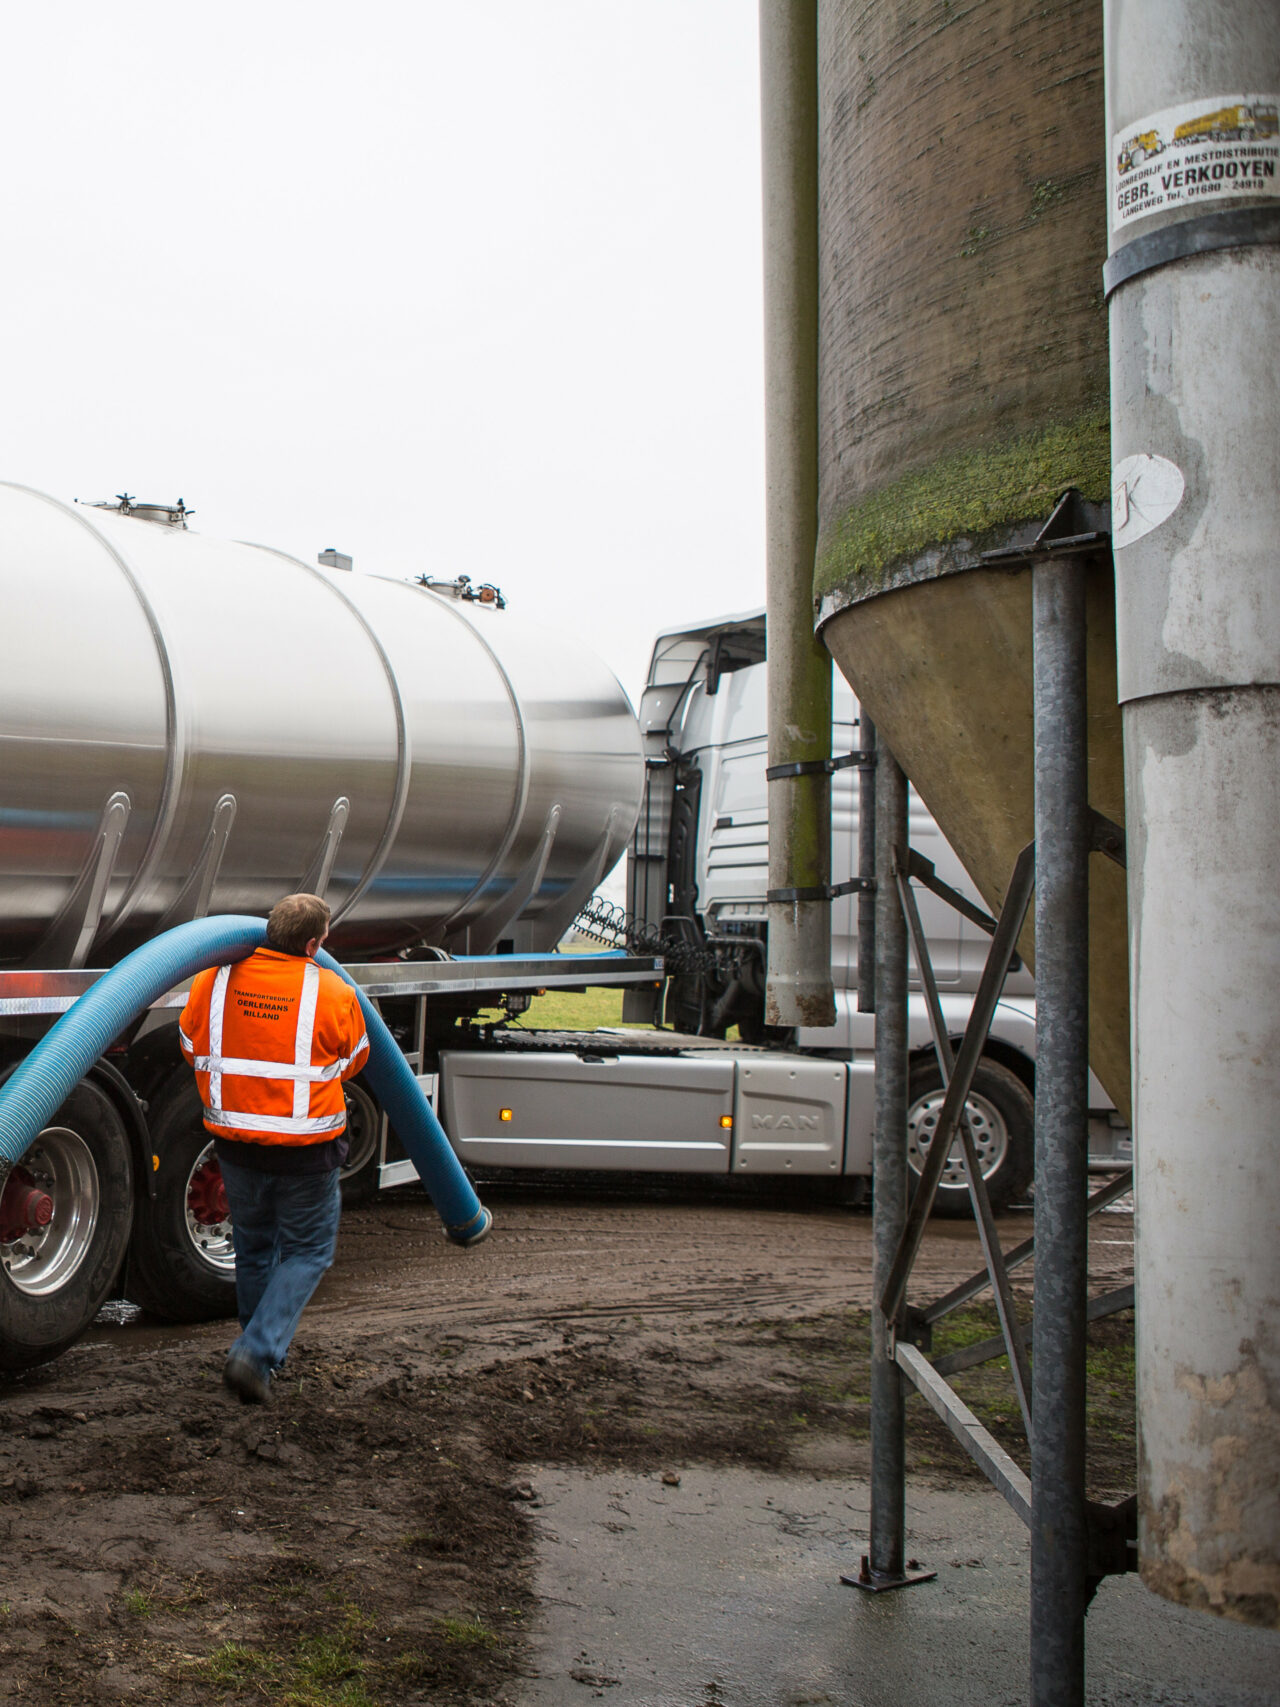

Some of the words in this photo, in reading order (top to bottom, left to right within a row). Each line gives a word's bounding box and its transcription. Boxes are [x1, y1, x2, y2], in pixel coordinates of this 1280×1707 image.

[1116, 163, 1162, 192] LOONBEDRIJF
[1167, 159, 1180, 169] EN
[1185, 147, 1279, 165] MESTDISTRIBUTIE
[1118, 182, 1154, 210] GEBR.
[1161, 160, 1274, 190] VERKOOYEN
[1122, 196, 1163, 219] LANGEWEG
[234, 989, 295, 1002] TRANSPORTBEDRIJF
[237, 999, 288, 1011] OERLEMANS
[243, 1010, 279, 1020] RILLAND
[752, 1114, 819, 1130] MAN
